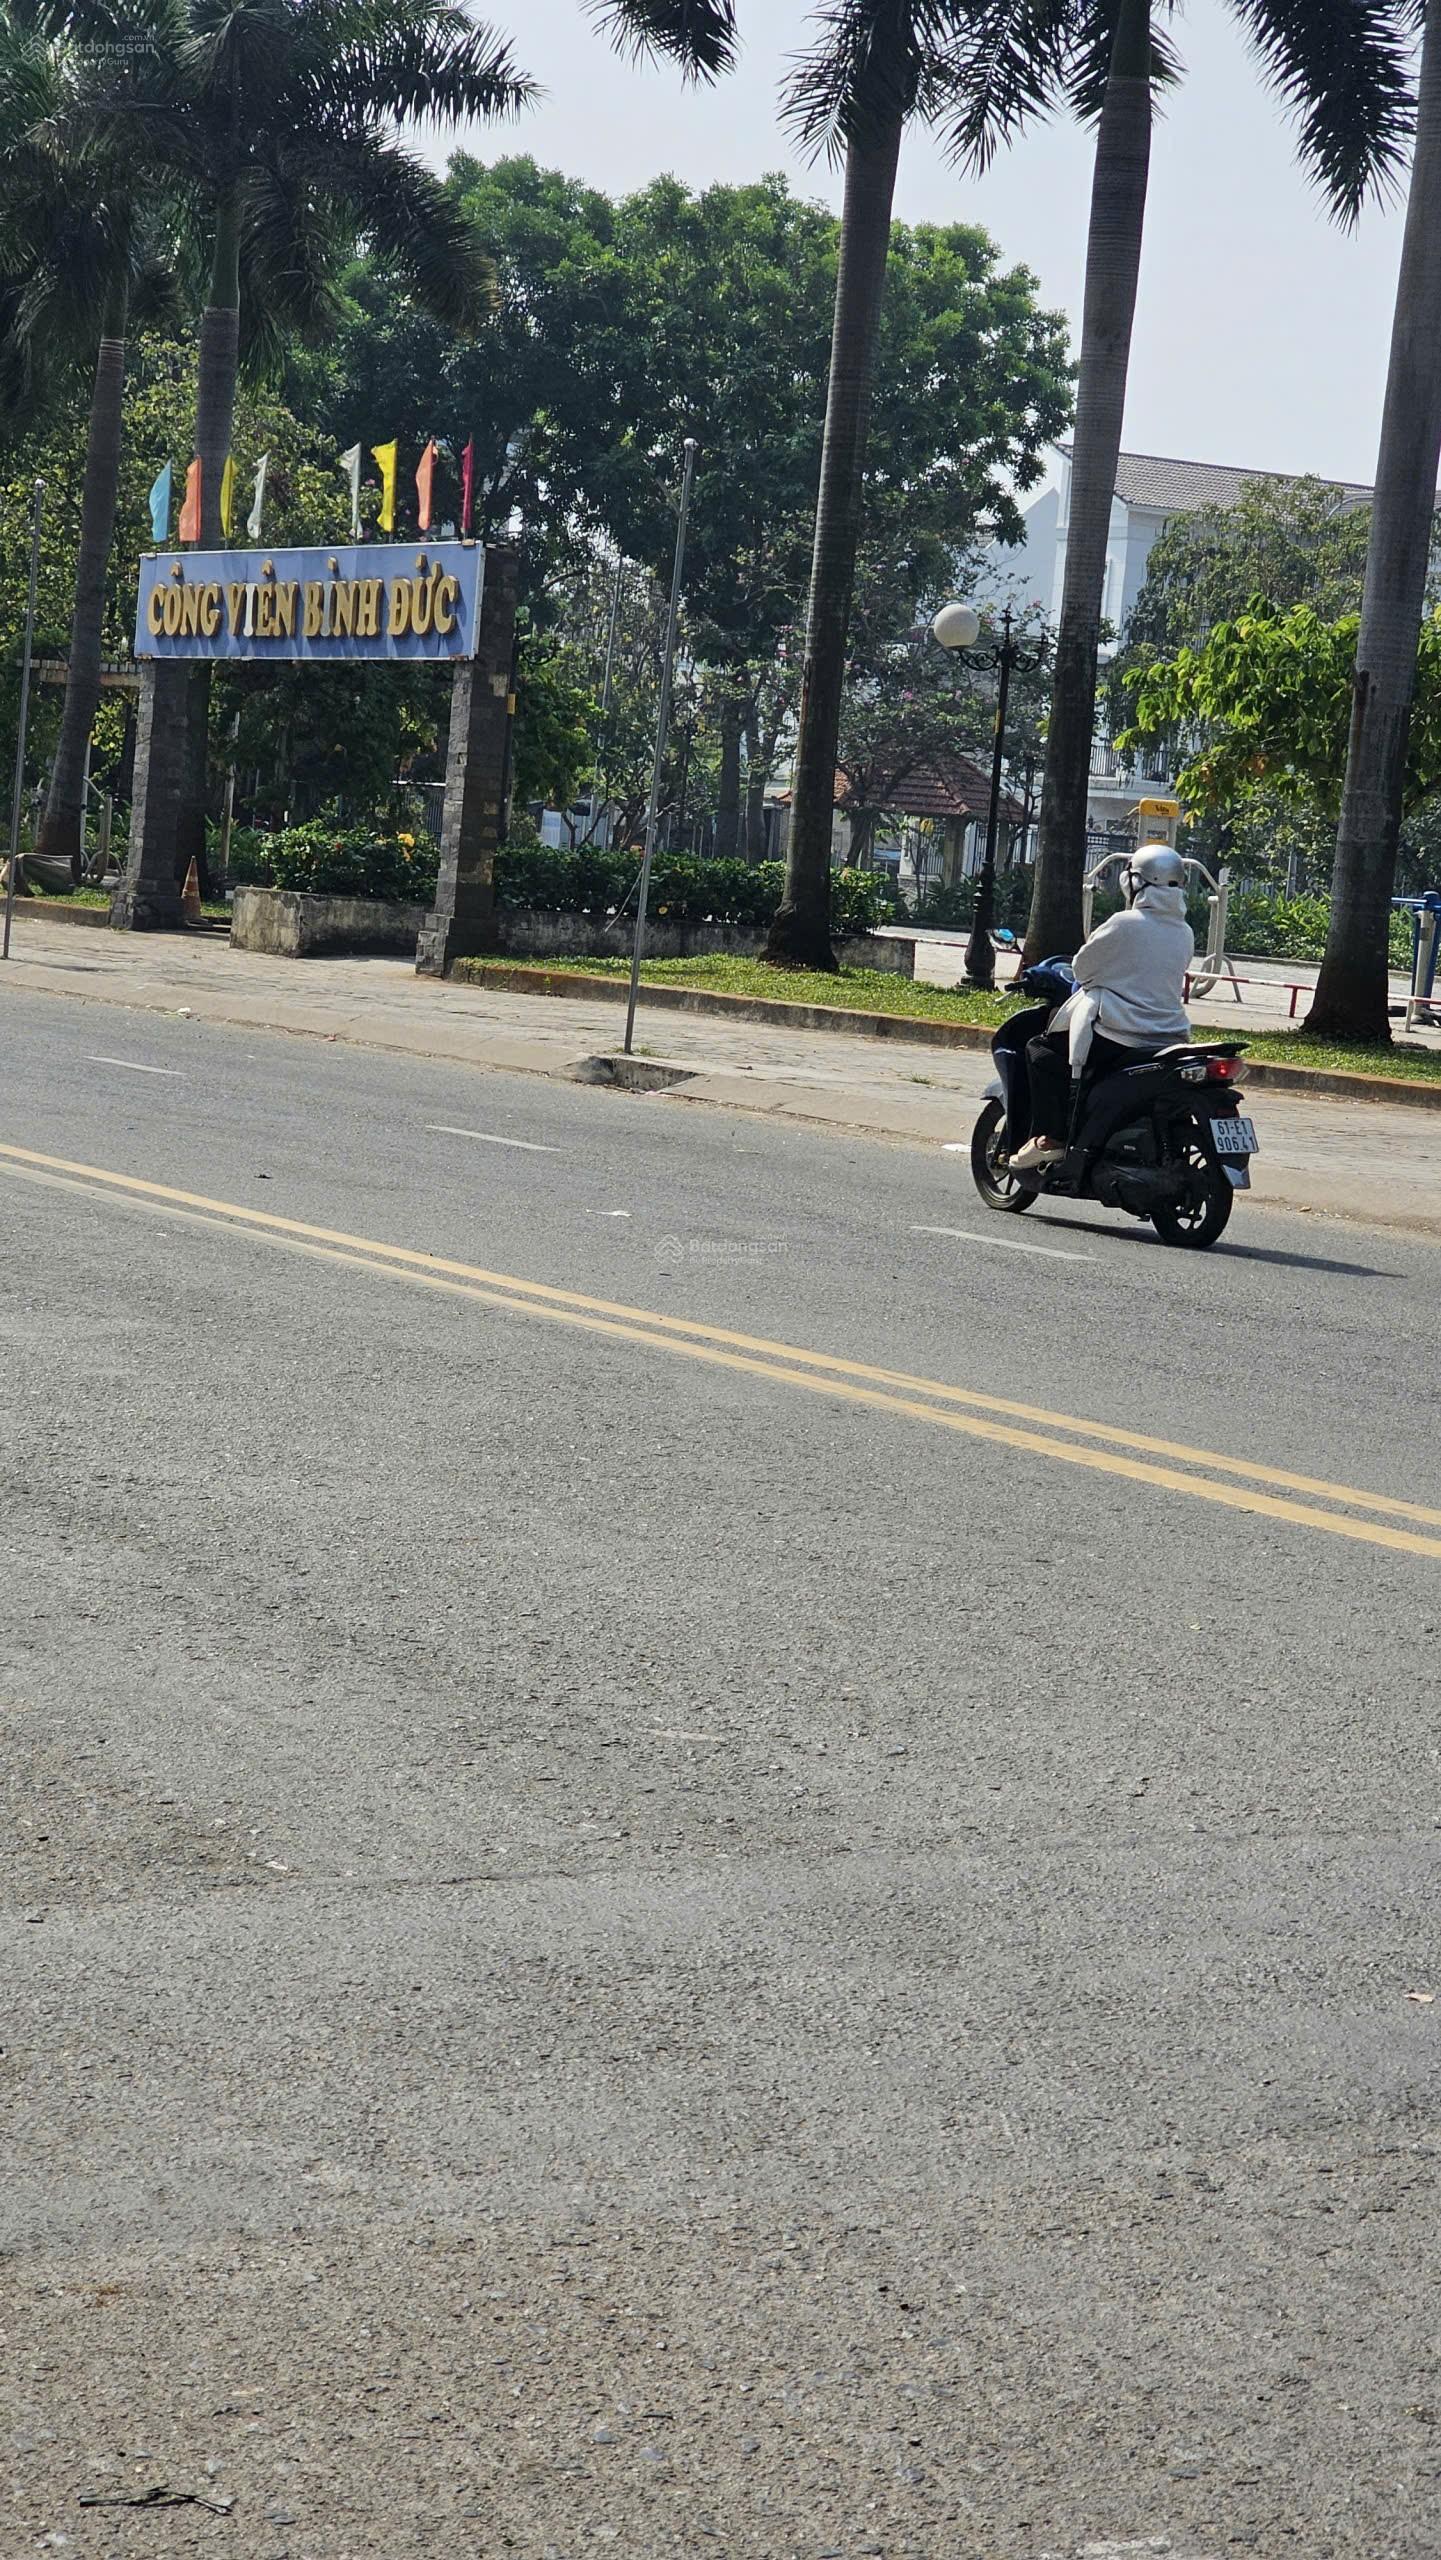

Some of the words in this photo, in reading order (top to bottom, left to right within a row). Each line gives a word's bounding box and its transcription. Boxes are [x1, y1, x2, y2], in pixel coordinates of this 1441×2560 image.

[148, 561, 221, 637] CÔNG
[227, 559, 298, 637] VIÊN
[302, 557, 382, 638] BÌNH
[387, 552, 458, 636] ĐỨC
[1217, 1120, 1248, 1135] 61-E1
[1217, 1136, 1256, 1151] 906.41
